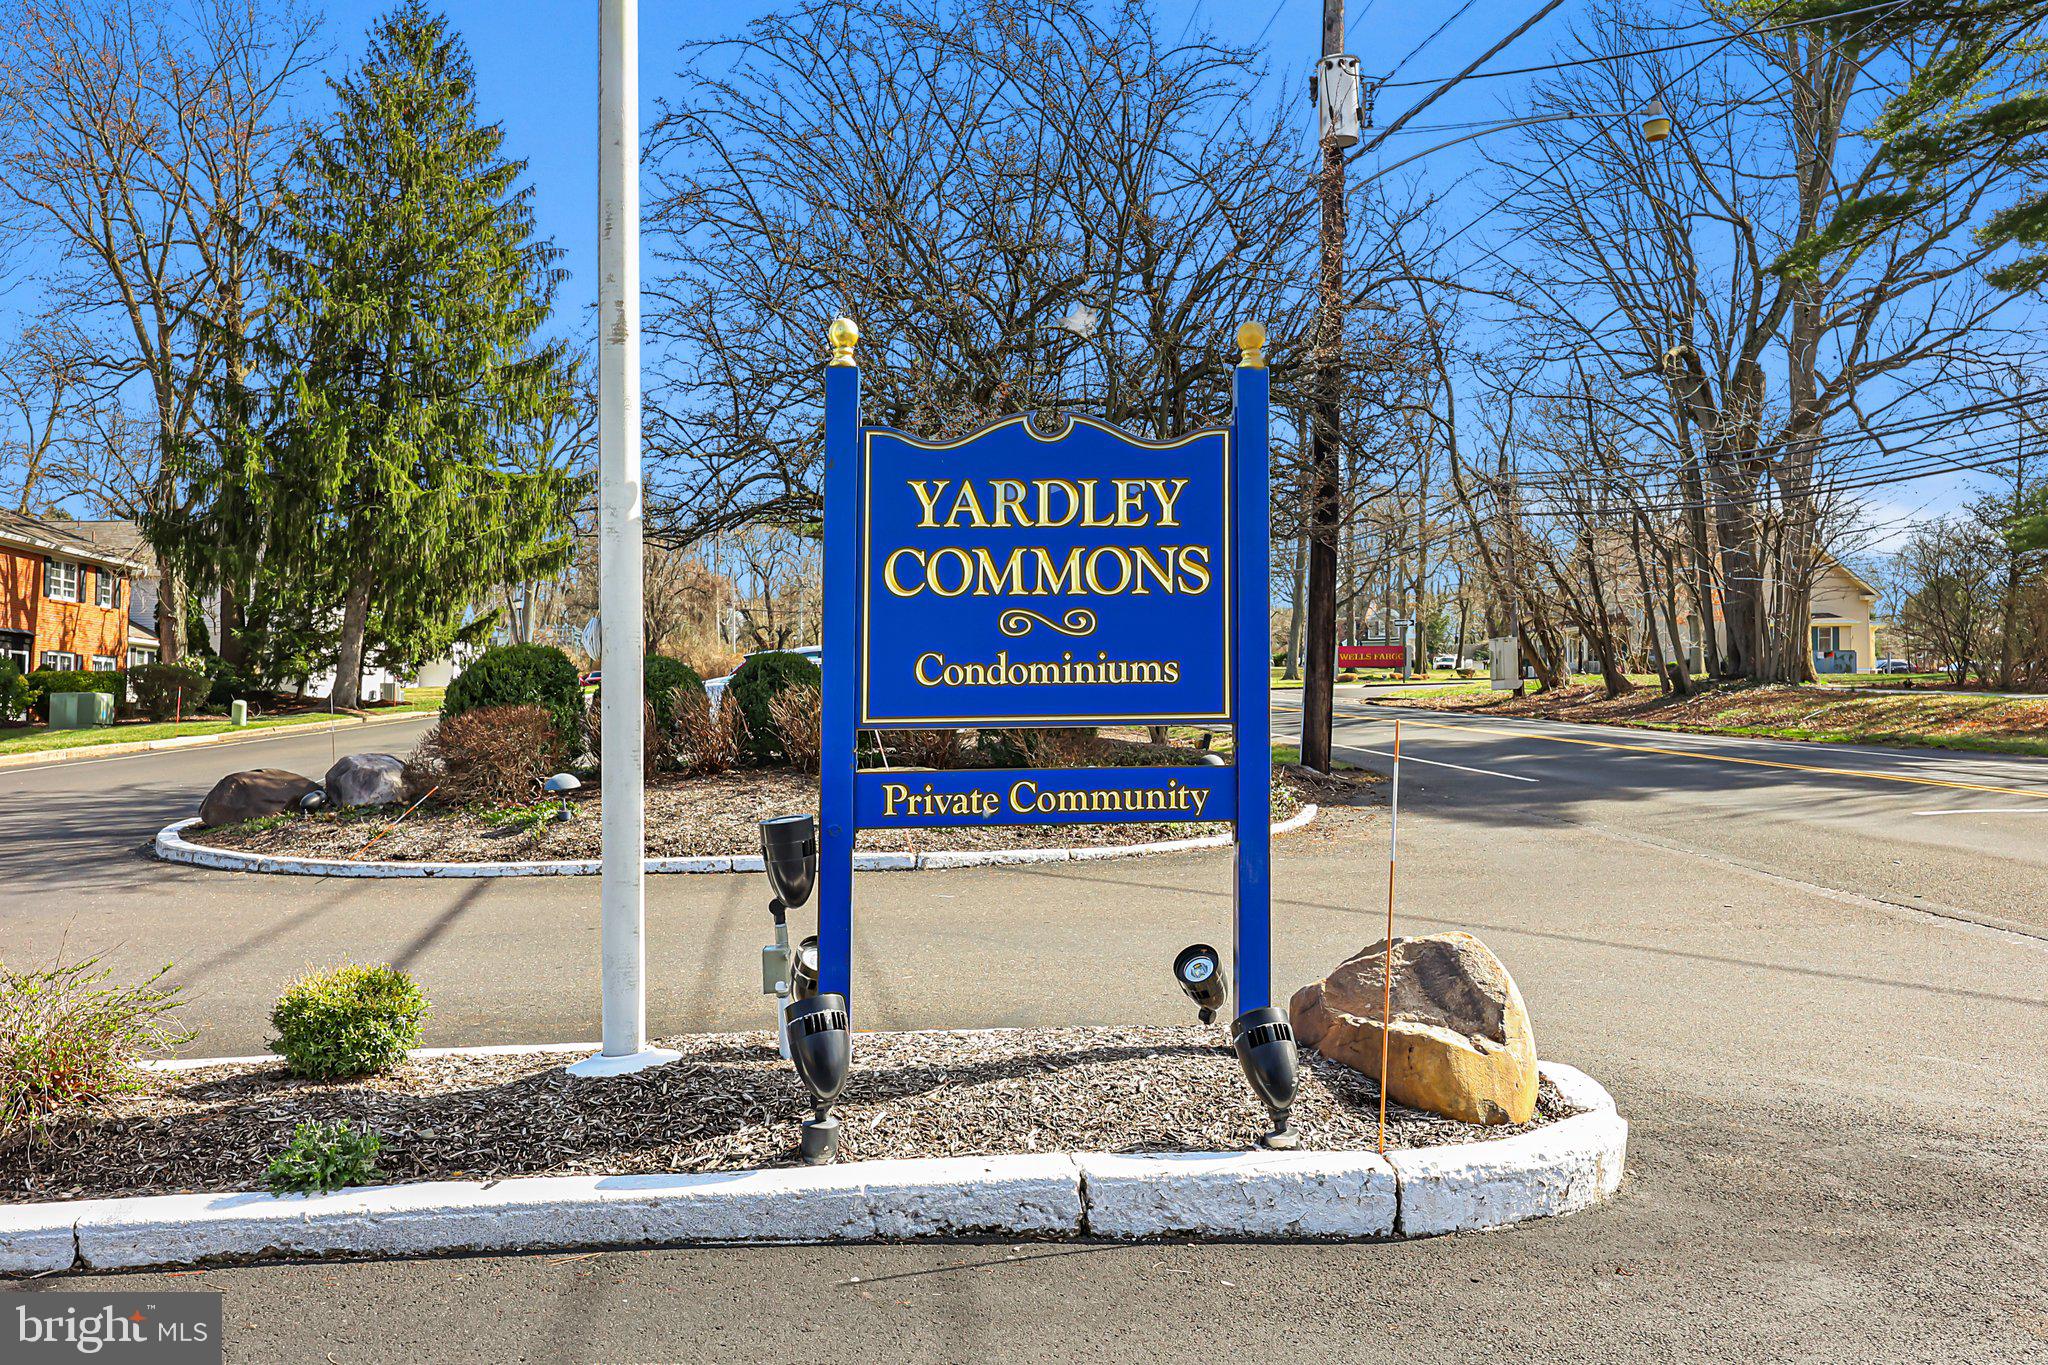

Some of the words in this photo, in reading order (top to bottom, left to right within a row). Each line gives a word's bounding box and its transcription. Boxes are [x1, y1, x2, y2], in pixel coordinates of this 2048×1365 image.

[907, 478, 1189, 528] YARDLEY
[883, 545, 1212, 597] COMMONS
[914, 651, 1180, 686] Condominiums
[881, 782, 1000, 817] Private
[1009, 779, 1210, 816] Community
